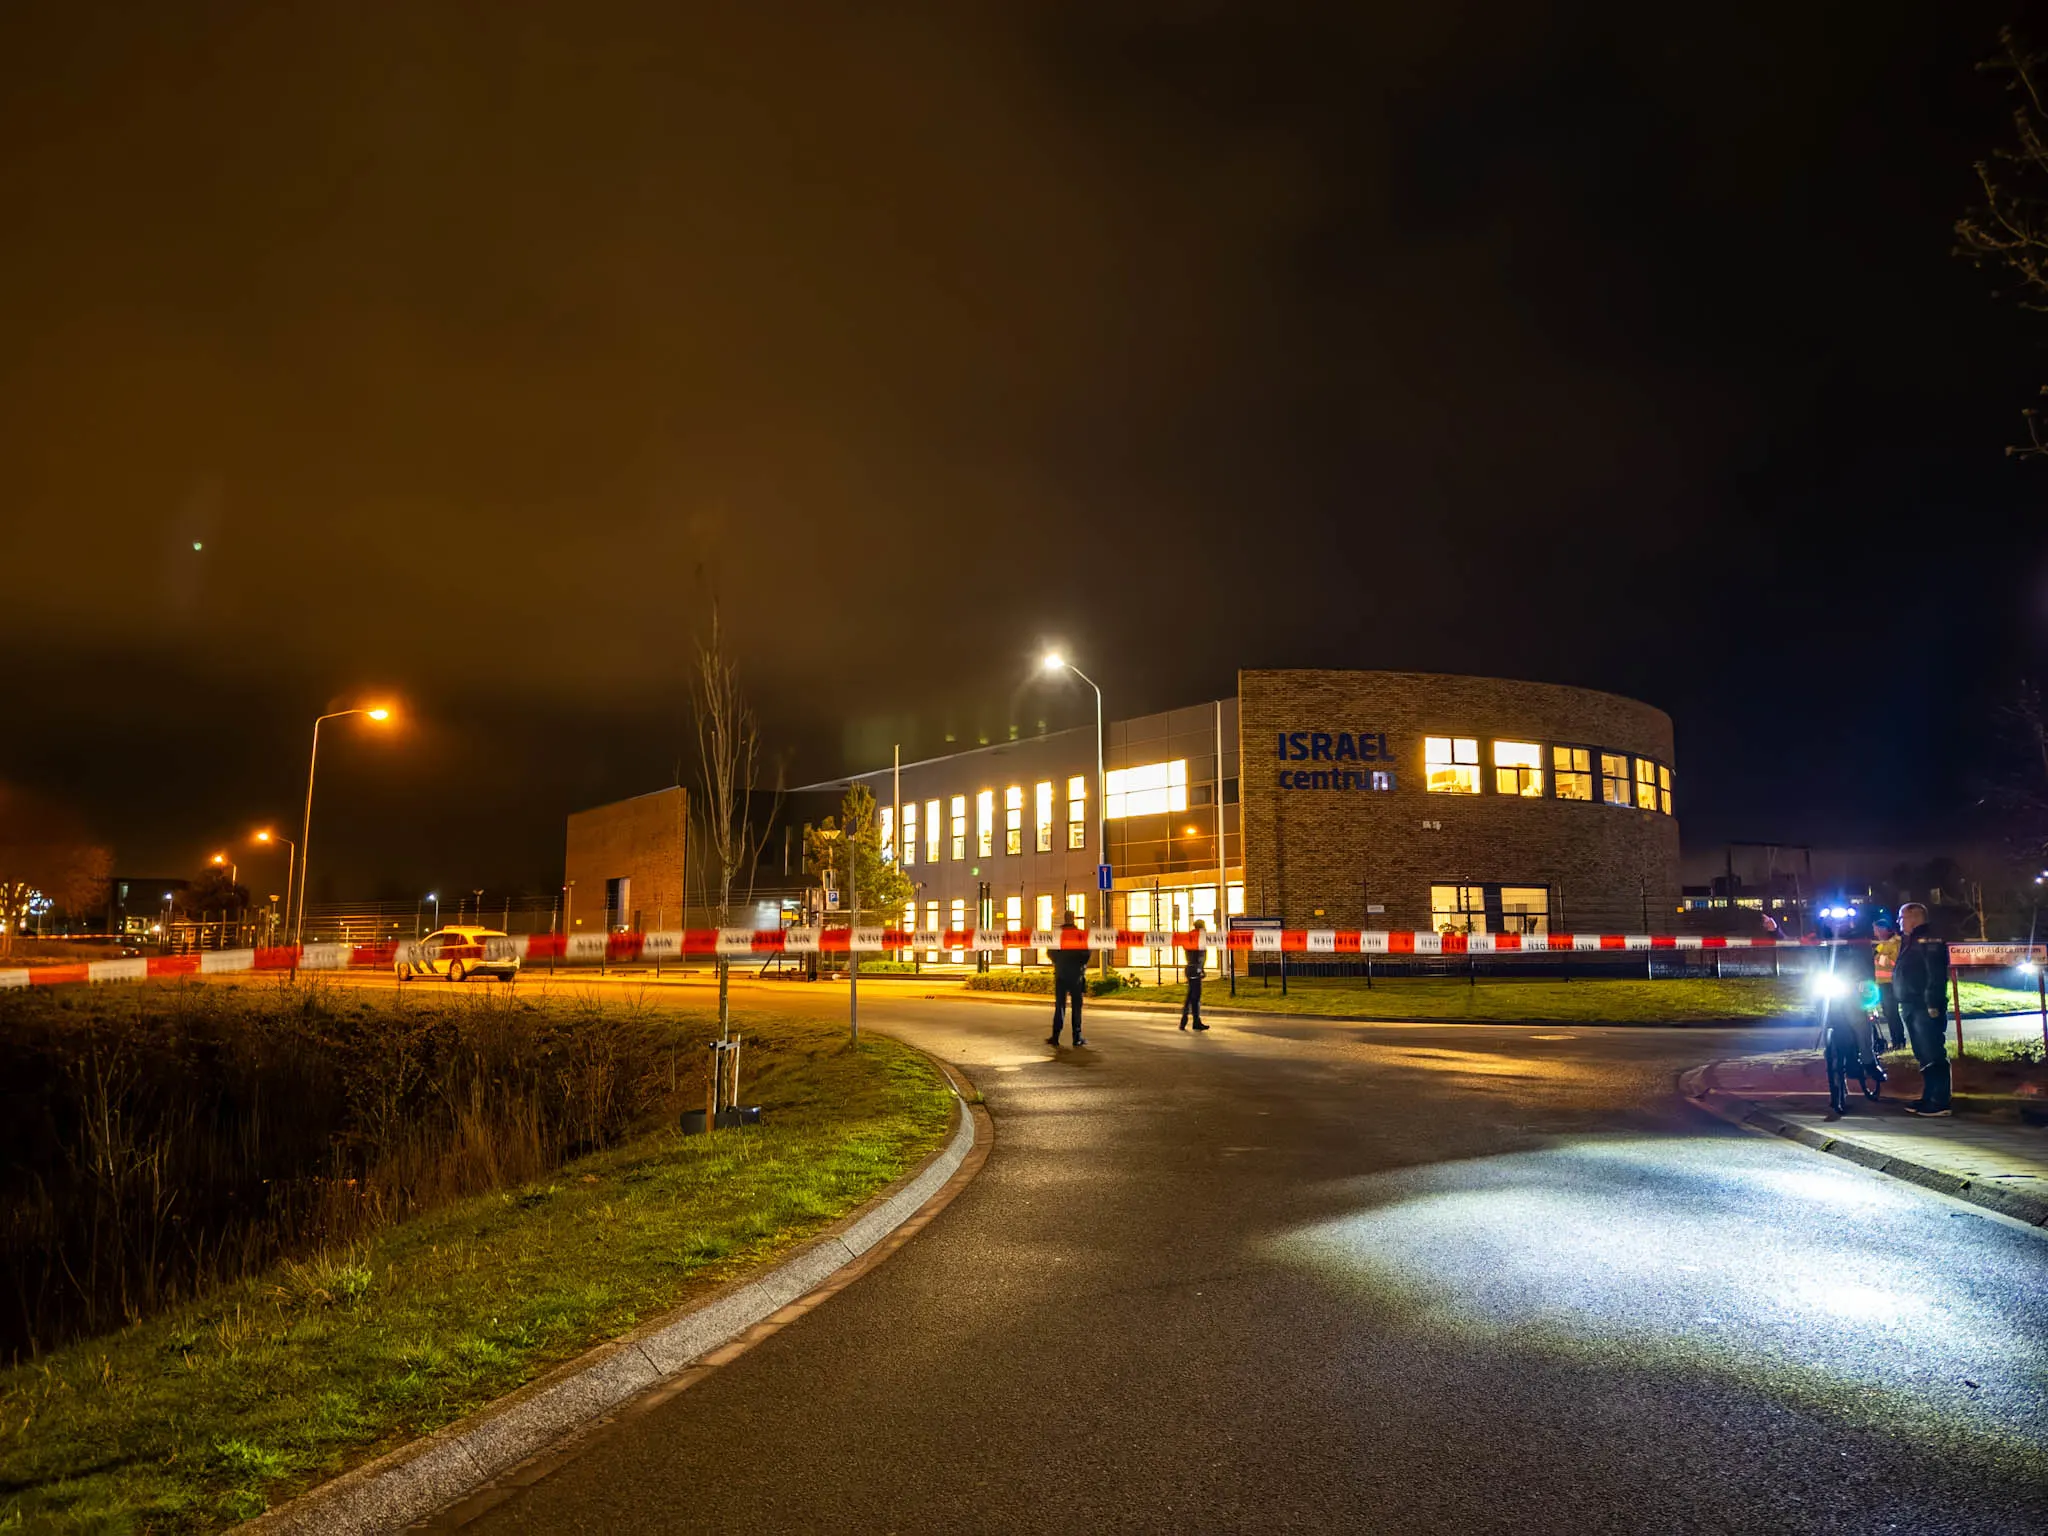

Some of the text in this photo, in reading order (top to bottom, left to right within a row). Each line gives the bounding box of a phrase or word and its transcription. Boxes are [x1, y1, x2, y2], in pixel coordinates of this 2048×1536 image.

[1278, 732, 1396, 762] ISRAEL
[1279, 767, 1398, 791] centrum
[786, 934, 812, 944] NIET
[1470, 939, 1490, 950] NIET
